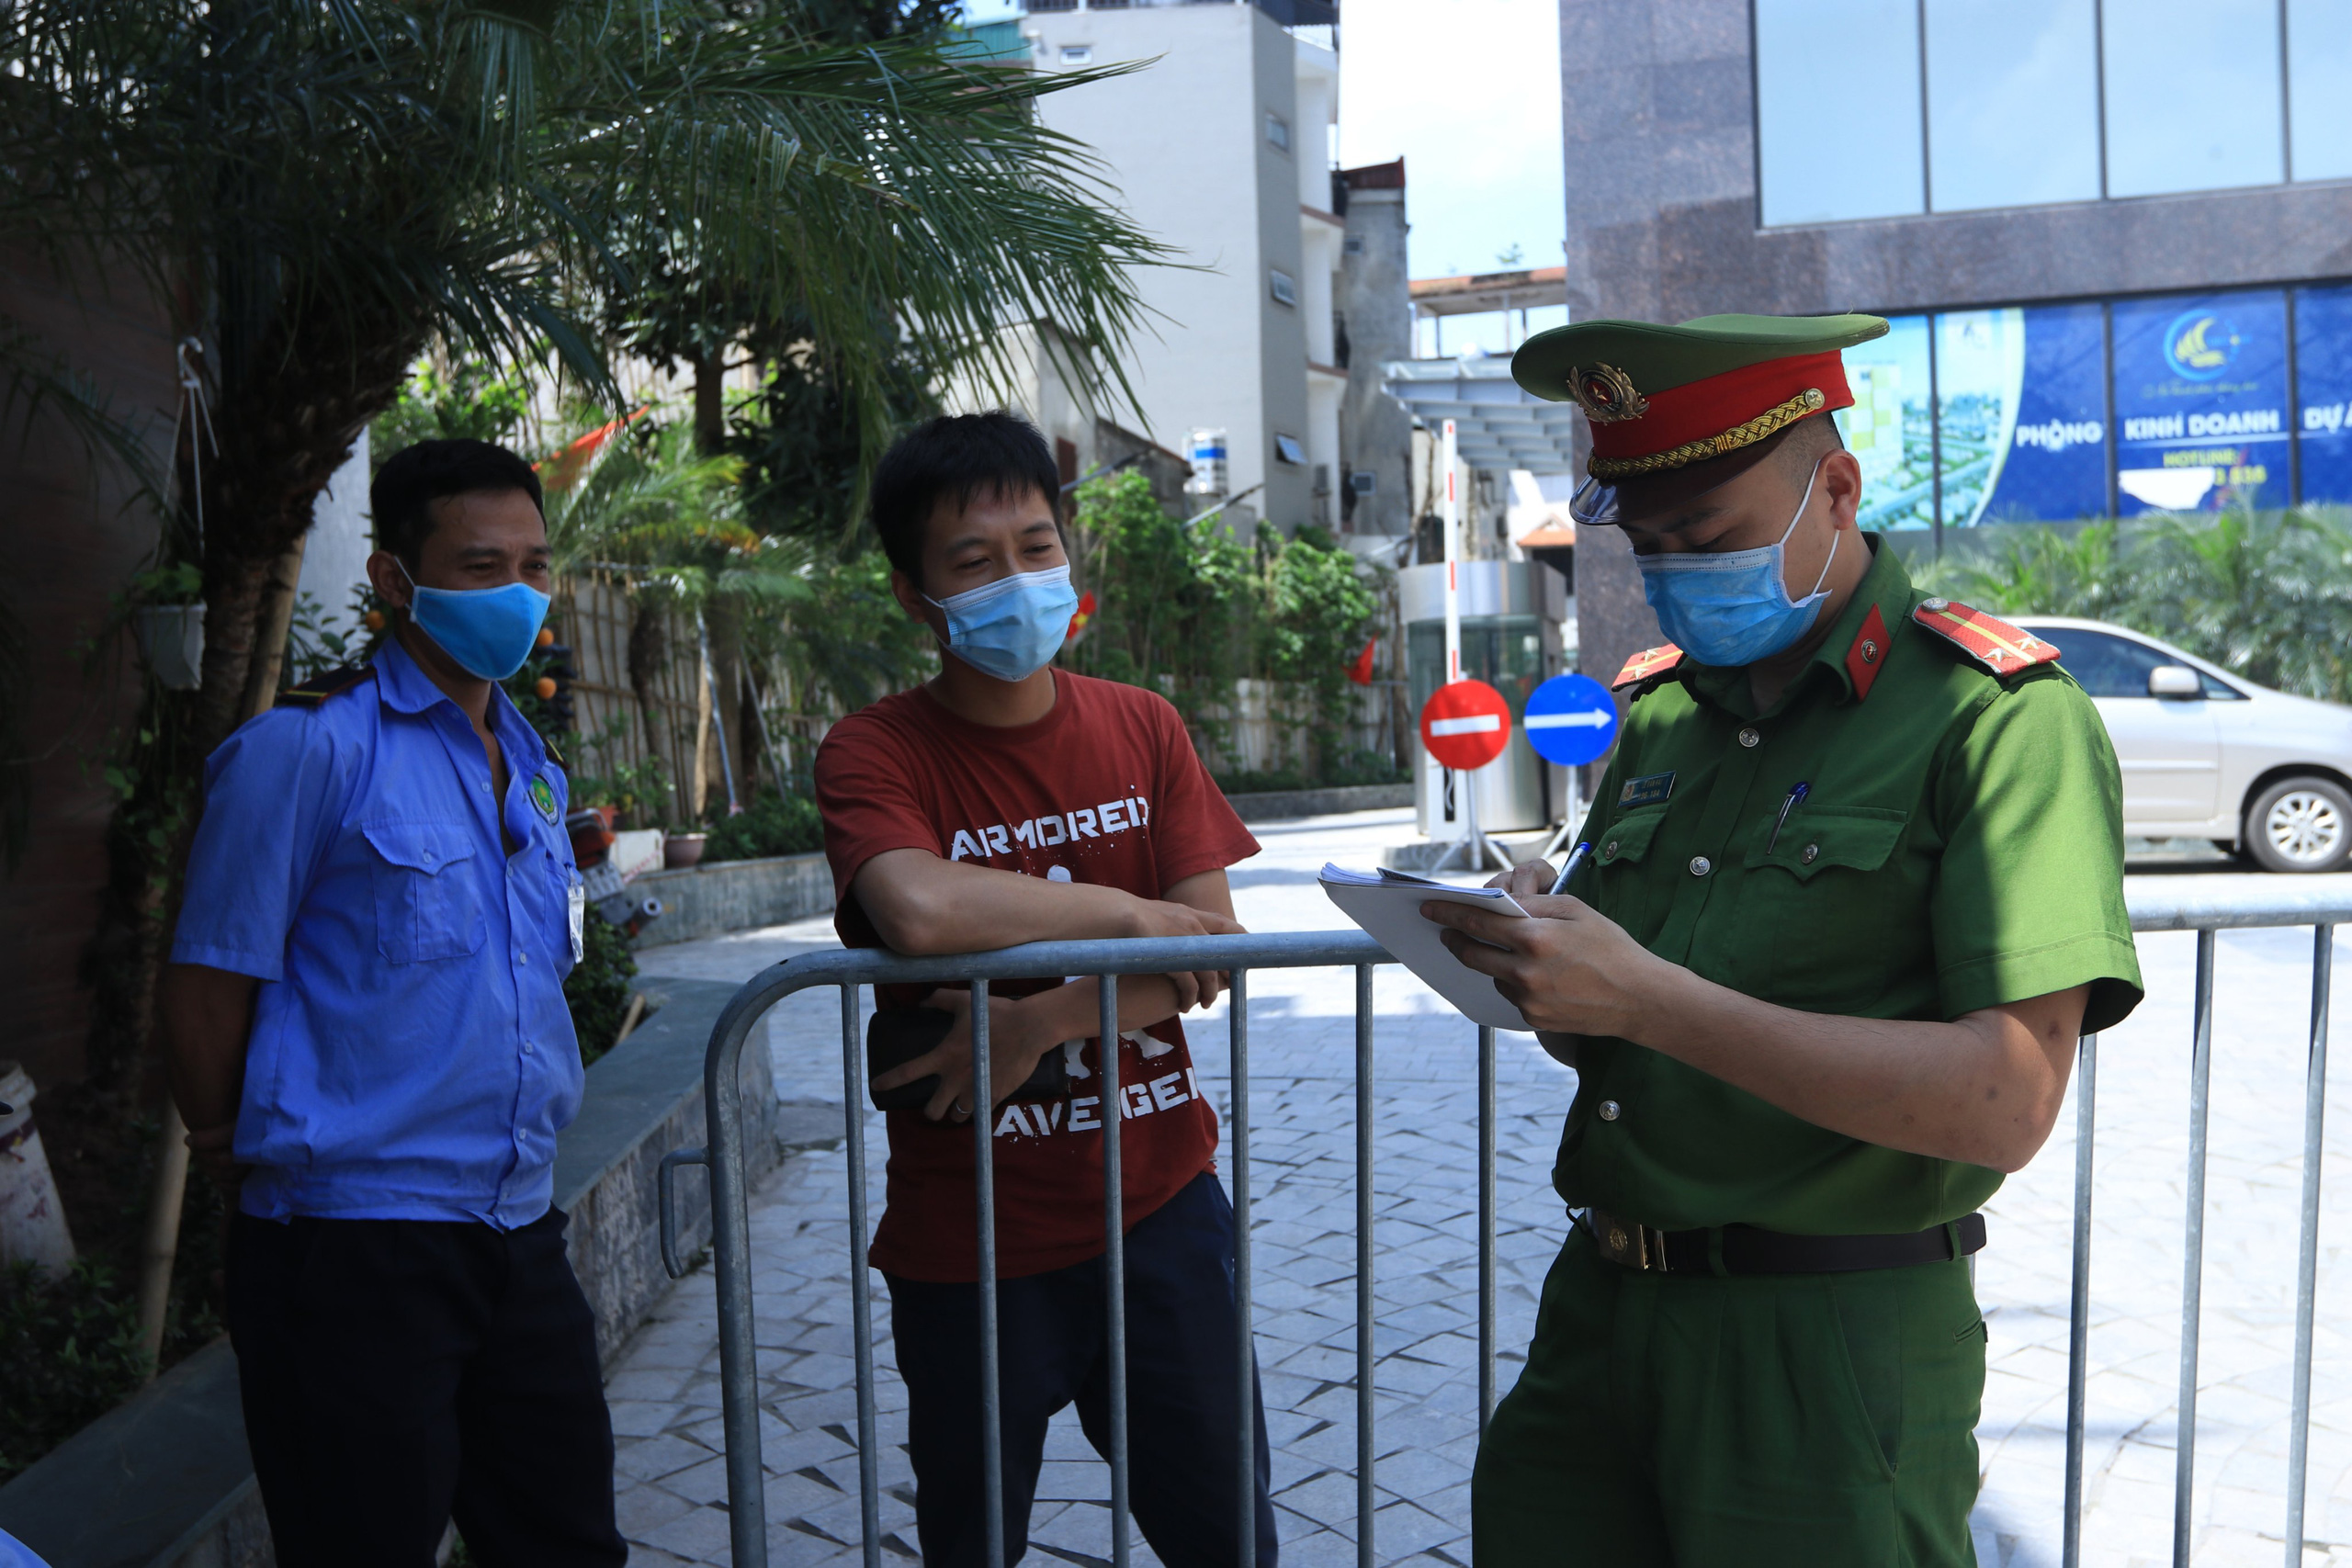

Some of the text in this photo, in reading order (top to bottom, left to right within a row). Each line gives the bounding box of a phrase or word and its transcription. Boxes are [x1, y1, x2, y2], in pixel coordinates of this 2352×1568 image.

[2124, 414, 2184, 440] KINH
[2188, 410, 2279, 436] DOANH
[951, 795, 1149, 862] ARMORED
[992, 1066, 1199, 1137] AVEGE
